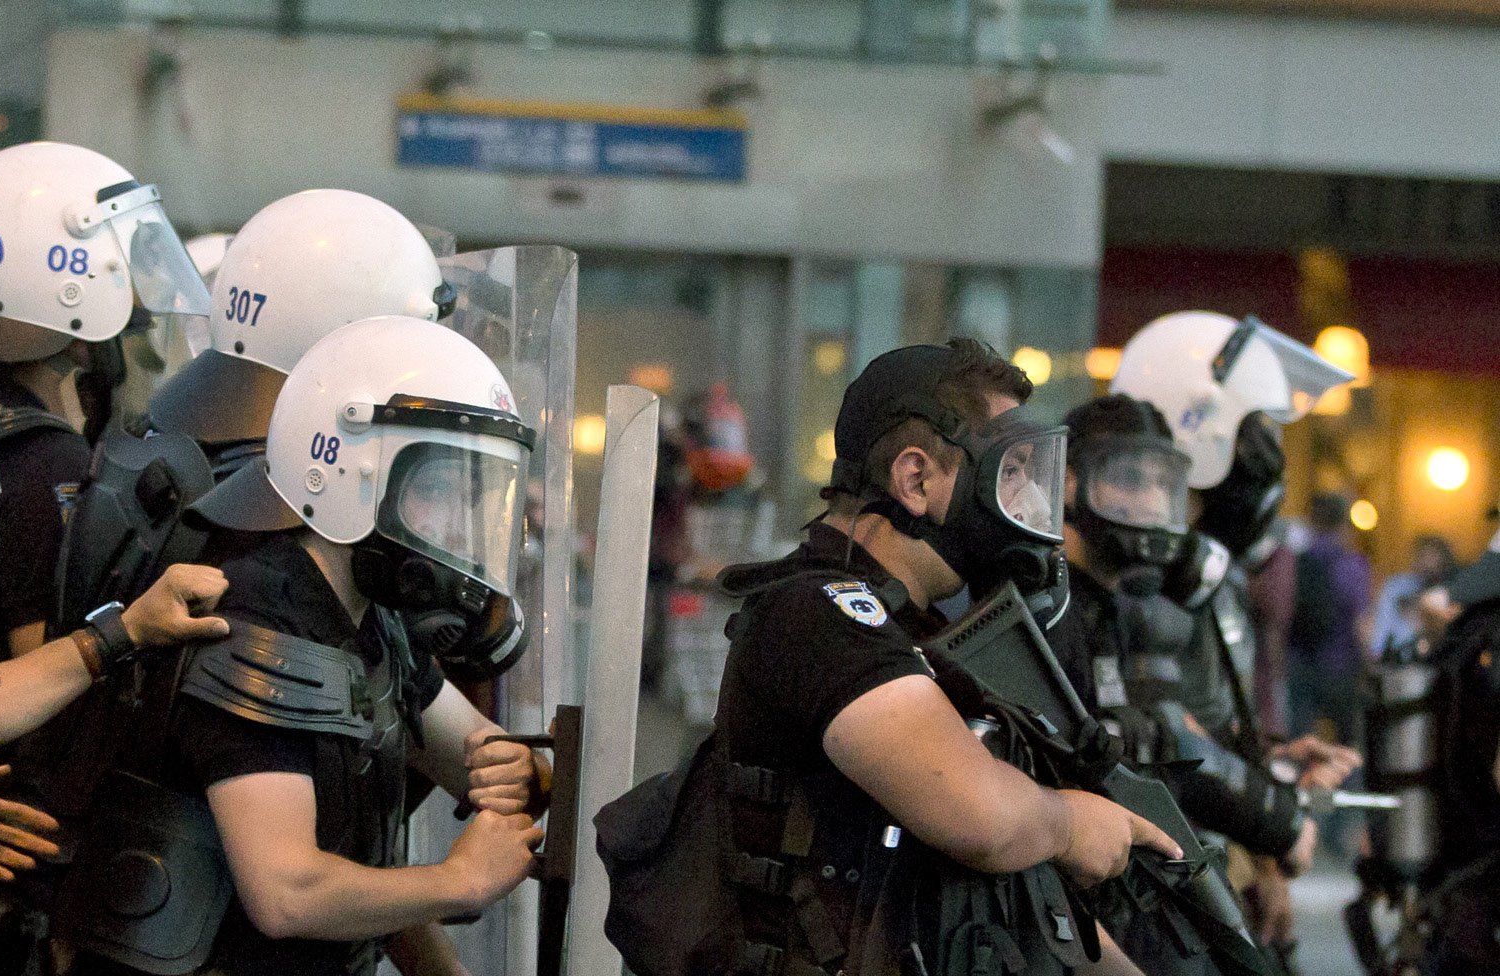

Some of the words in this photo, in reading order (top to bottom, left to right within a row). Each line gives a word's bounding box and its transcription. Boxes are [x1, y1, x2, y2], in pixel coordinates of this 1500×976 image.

[48, 244, 89, 276] 08
[226, 286, 267, 327] 307
[310, 431, 341, 465] 08
